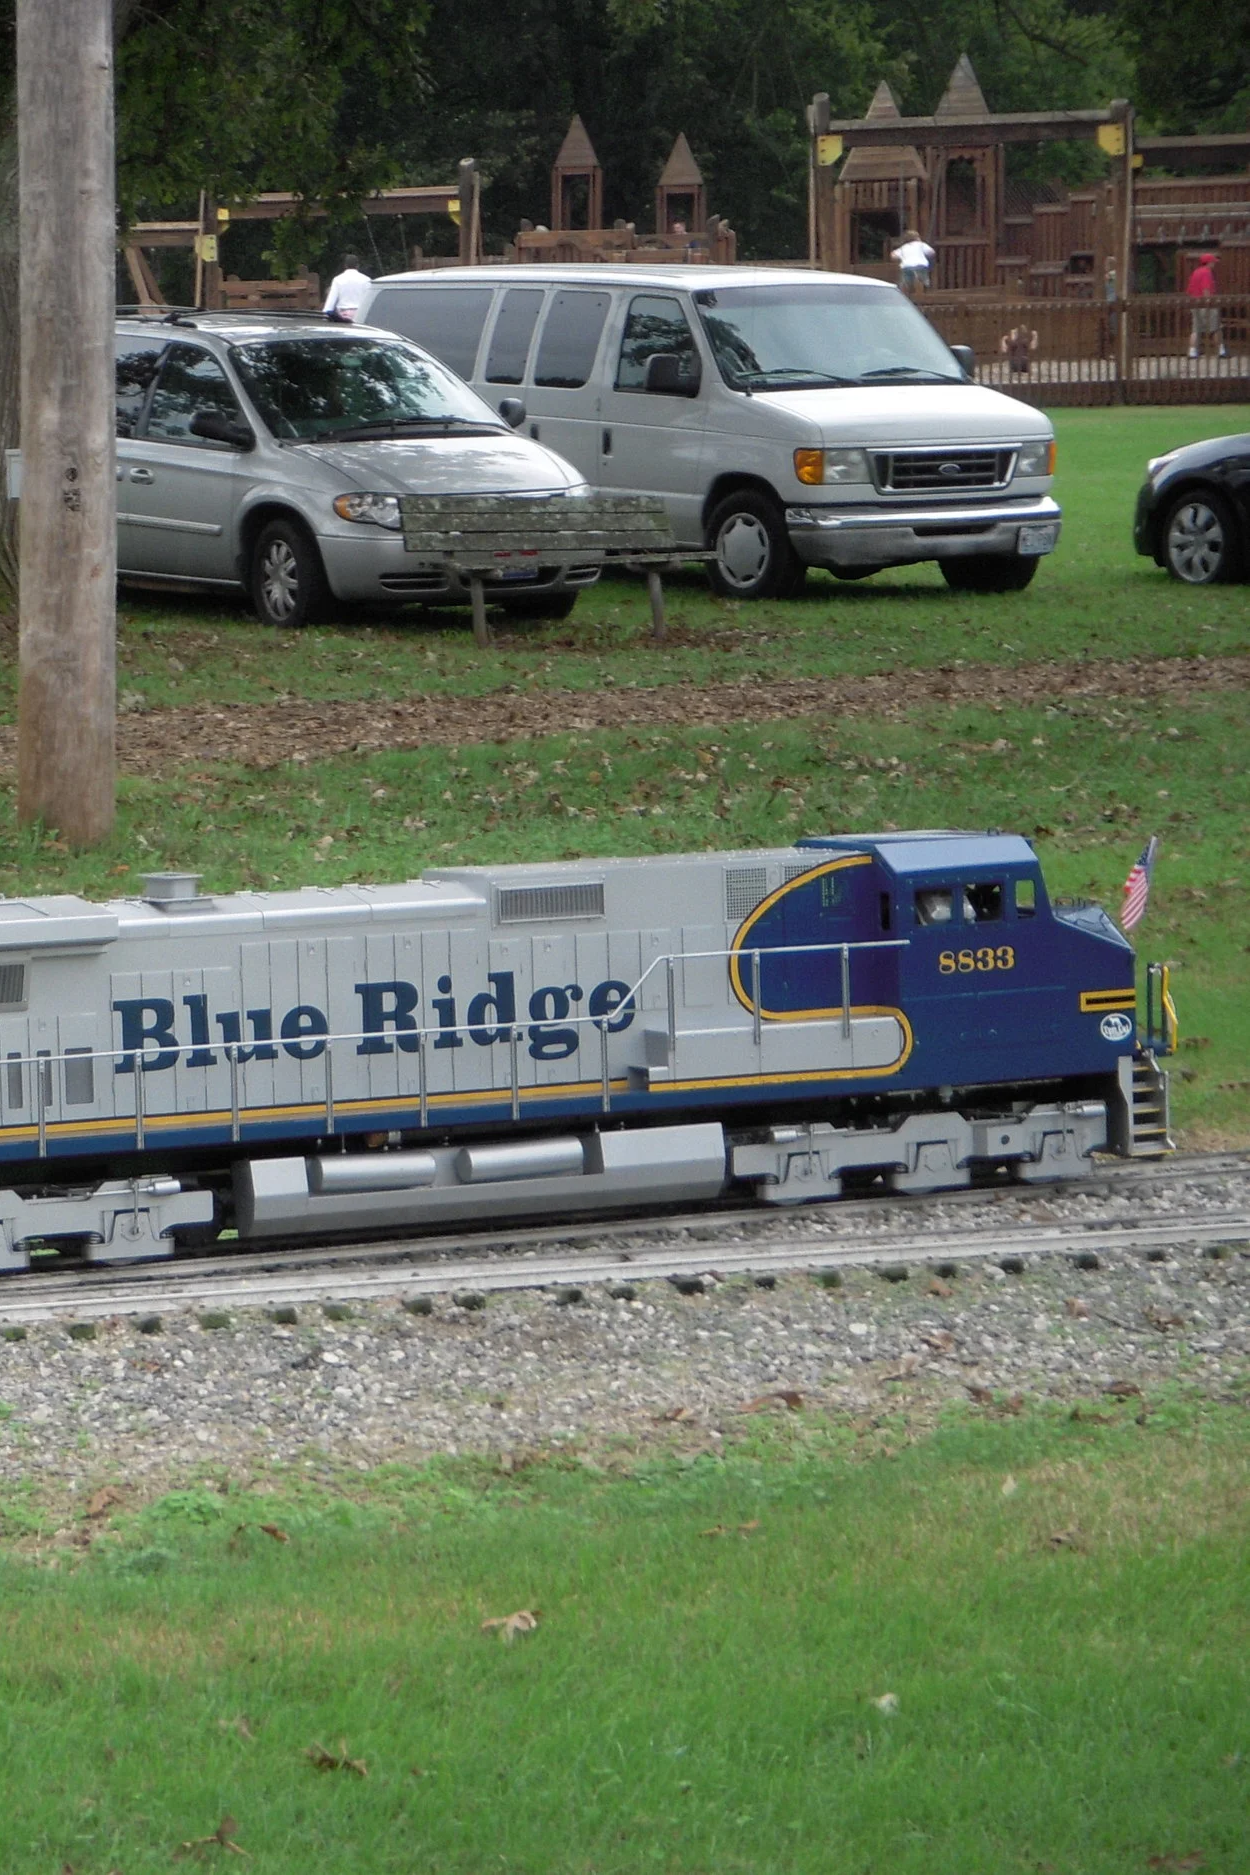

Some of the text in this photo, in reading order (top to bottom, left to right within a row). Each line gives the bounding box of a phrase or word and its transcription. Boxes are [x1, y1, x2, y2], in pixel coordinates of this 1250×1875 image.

[939, 945, 1015, 974] 8833
[113, 971, 636, 1074] Blue Ridge
